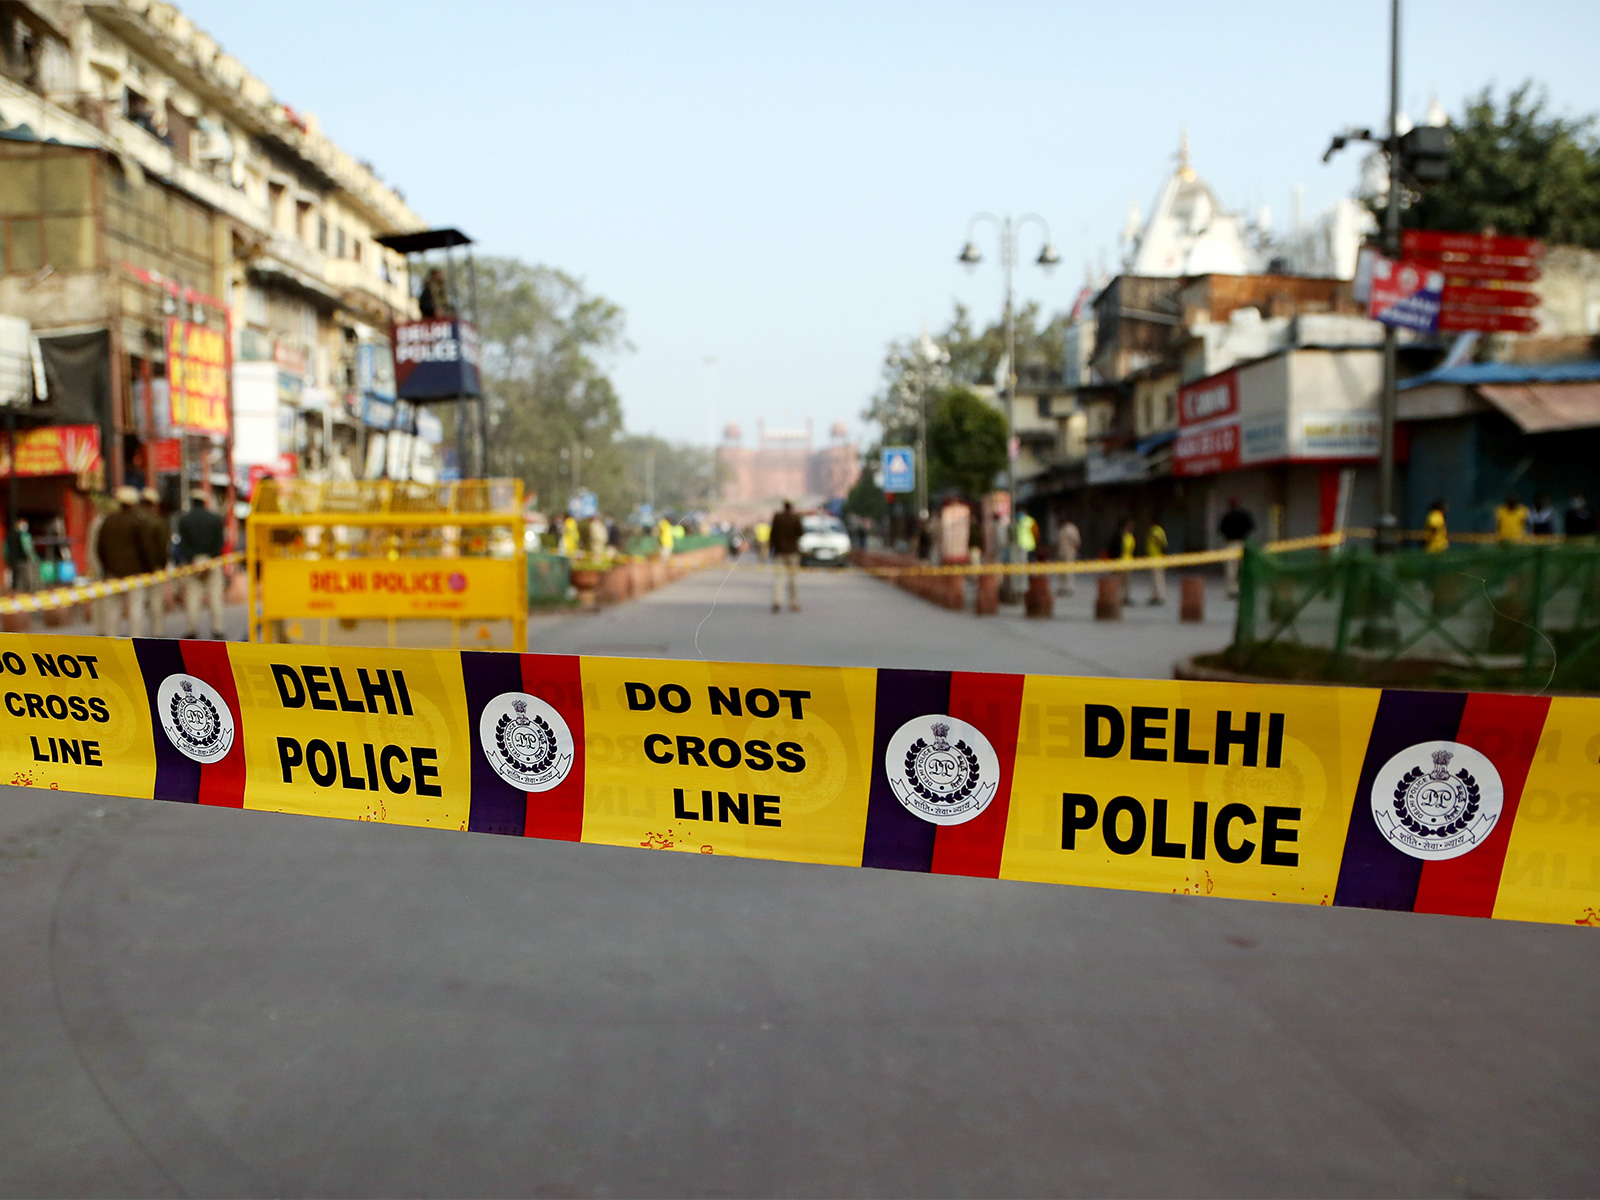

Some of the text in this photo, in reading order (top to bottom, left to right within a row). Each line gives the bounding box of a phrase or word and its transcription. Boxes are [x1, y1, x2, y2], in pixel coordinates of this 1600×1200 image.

[372, 571, 443, 594] POLICE
[0, 652, 99, 680] O NOT
[5, 692, 110, 723] CROSS
[270, 664, 414, 716] DELHI
[625, 682, 812, 720] DO NOT
[30, 736, 103, 767] LINE
[644, 734, 806, 773] CROSS
[1085, 704, 1285, 769] DELHI
[277, 737, 442, 798] POLICE
[918, 748, 933, 787] DELHI POLICE
[674, 789, 782, 828] LINE
[1409, 777, 1428, 819] DELHI POLICE
[1062, 793, 1302, 868] POLICE
